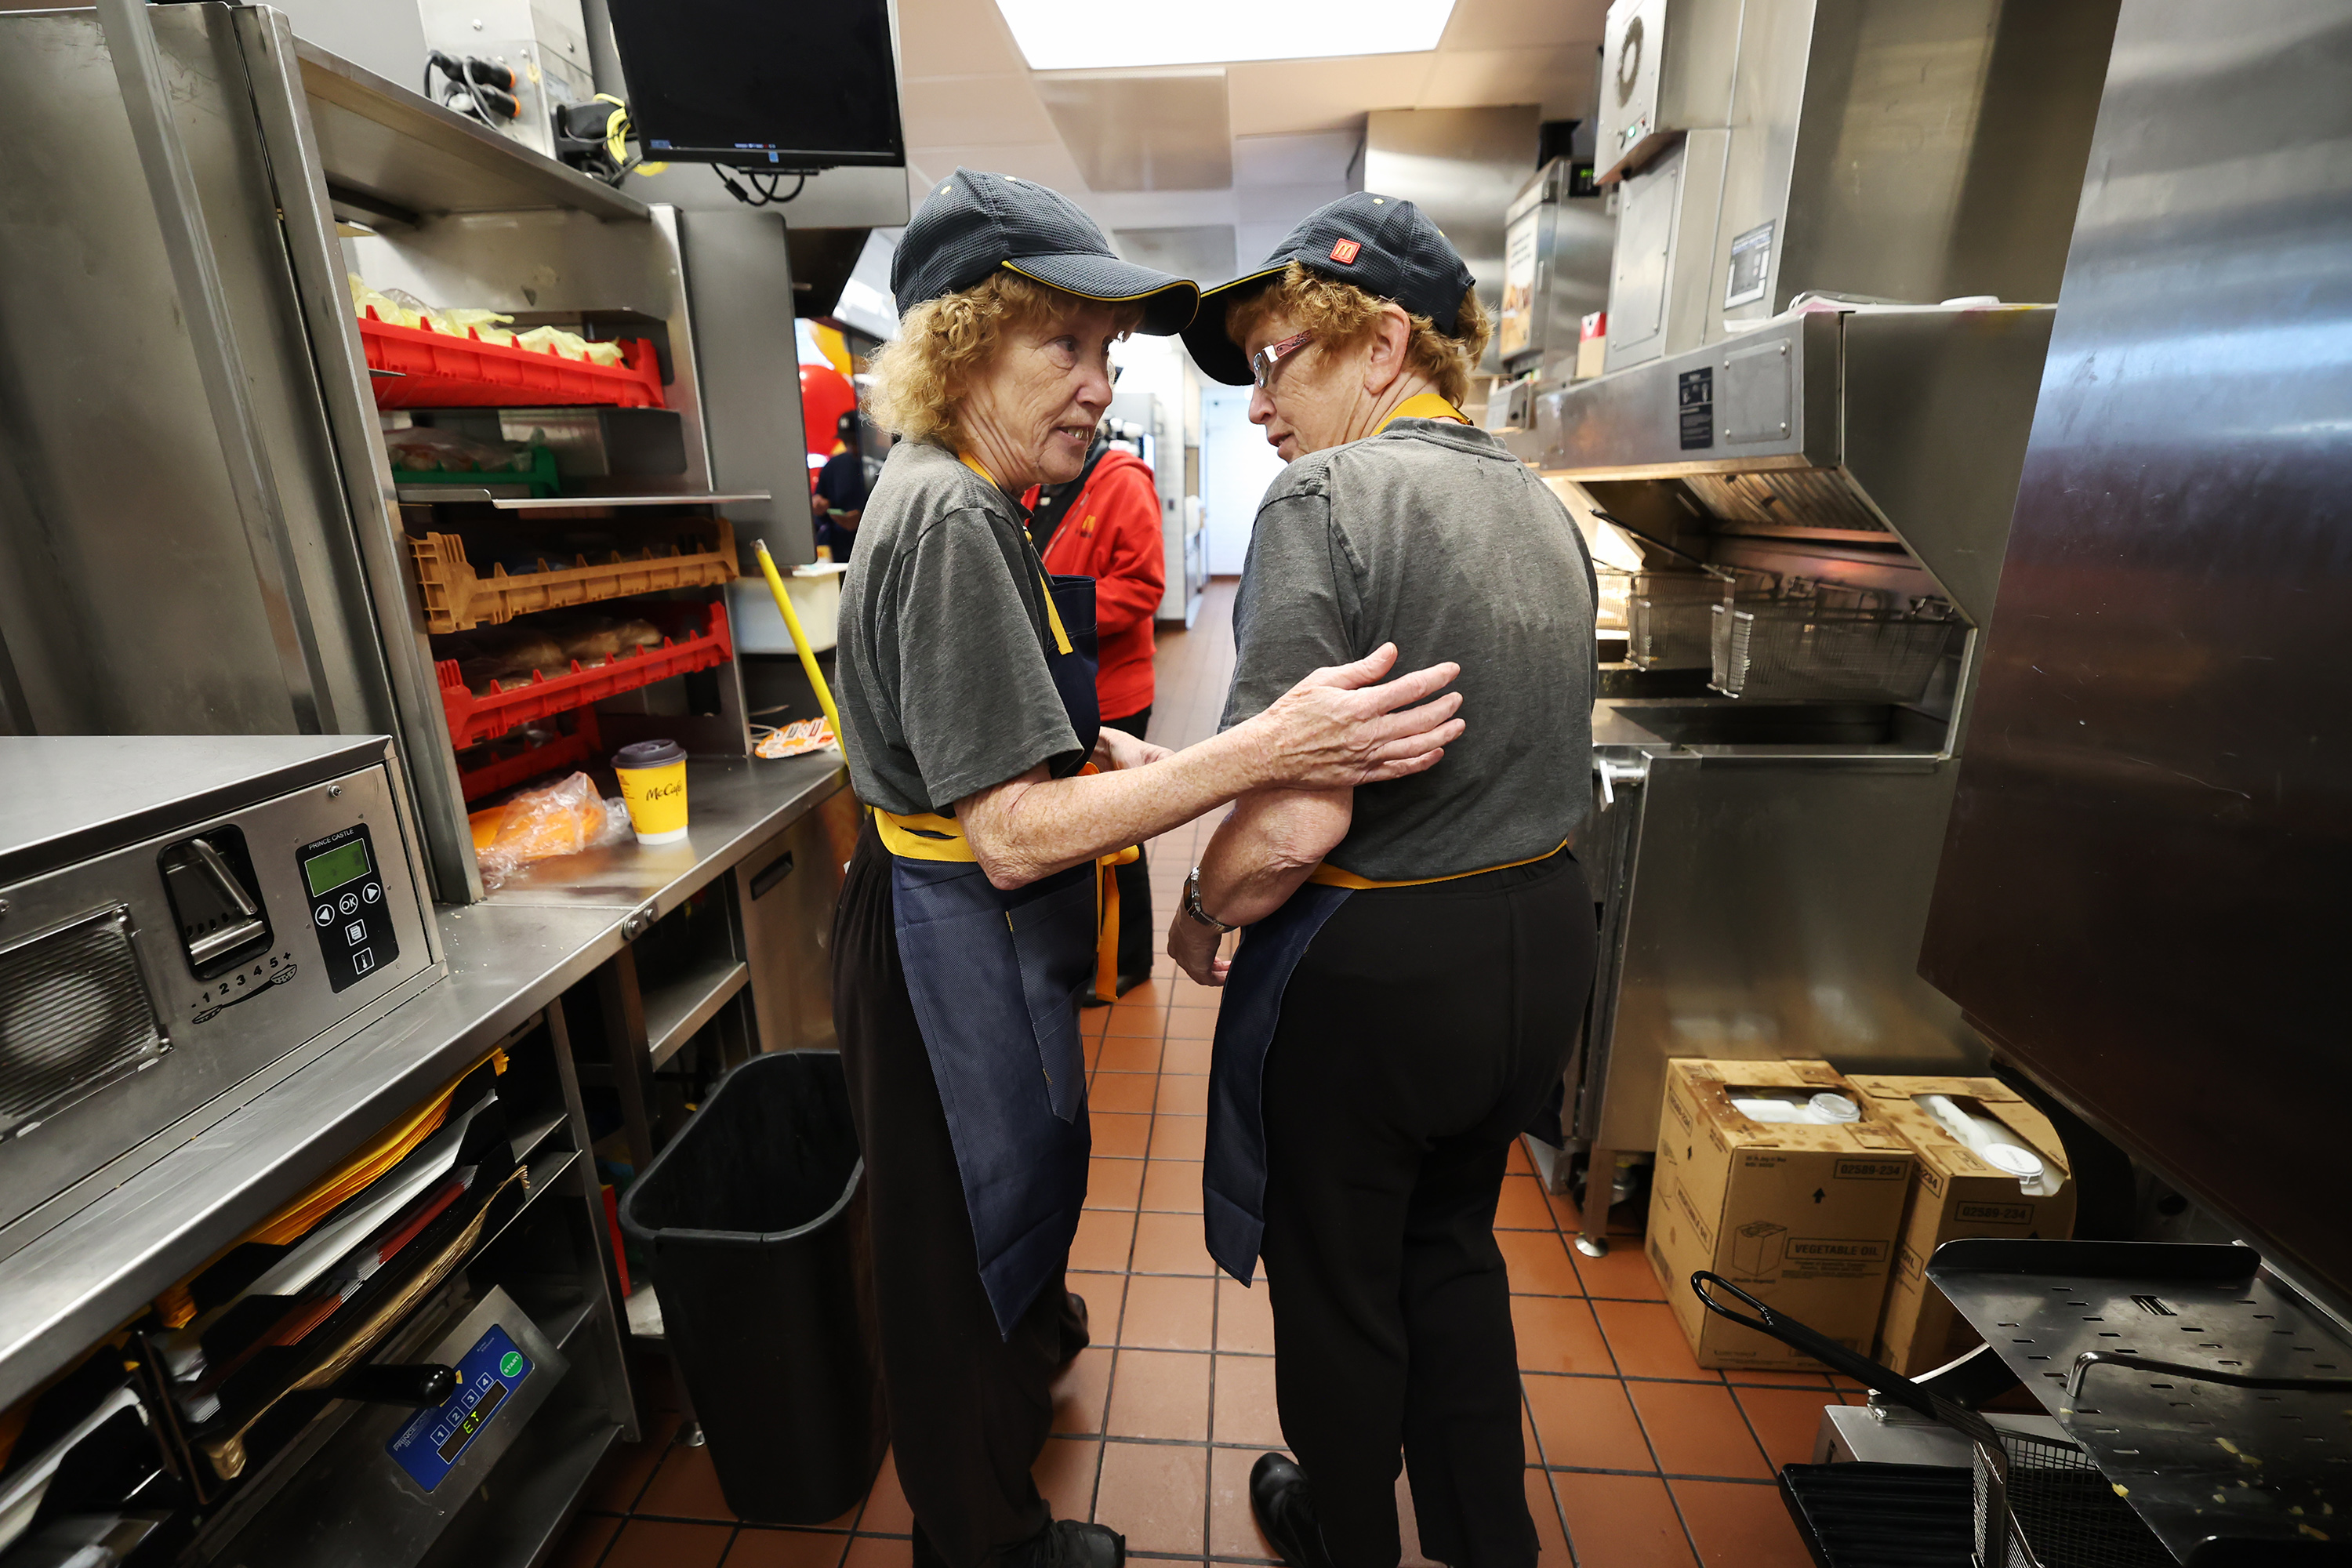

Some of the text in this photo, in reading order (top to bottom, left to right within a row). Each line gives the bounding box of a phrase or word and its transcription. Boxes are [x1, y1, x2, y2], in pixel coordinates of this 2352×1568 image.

[308, 828, 354, 851] PRINCE CASTLE
[341, 898, 357, 910] OK
[202, 992, 210, 1003] 1
[219, 982, 230, 995] 2
[236, 975, 246, 985] 3
[253, 965, 263, 976] 4
[270, 956, 278, 967] 5
[1962, 1206, 2026, 1219] 02589-234
[1795, 1243, 1878, 1256] VEGETABLE OIL
[503, 1355, 521, 1374] START
[481, 1377, 489, 1386] 4
[466, 1395, 474, 1403] 3
[452, 1412, 460, 1421] 2
